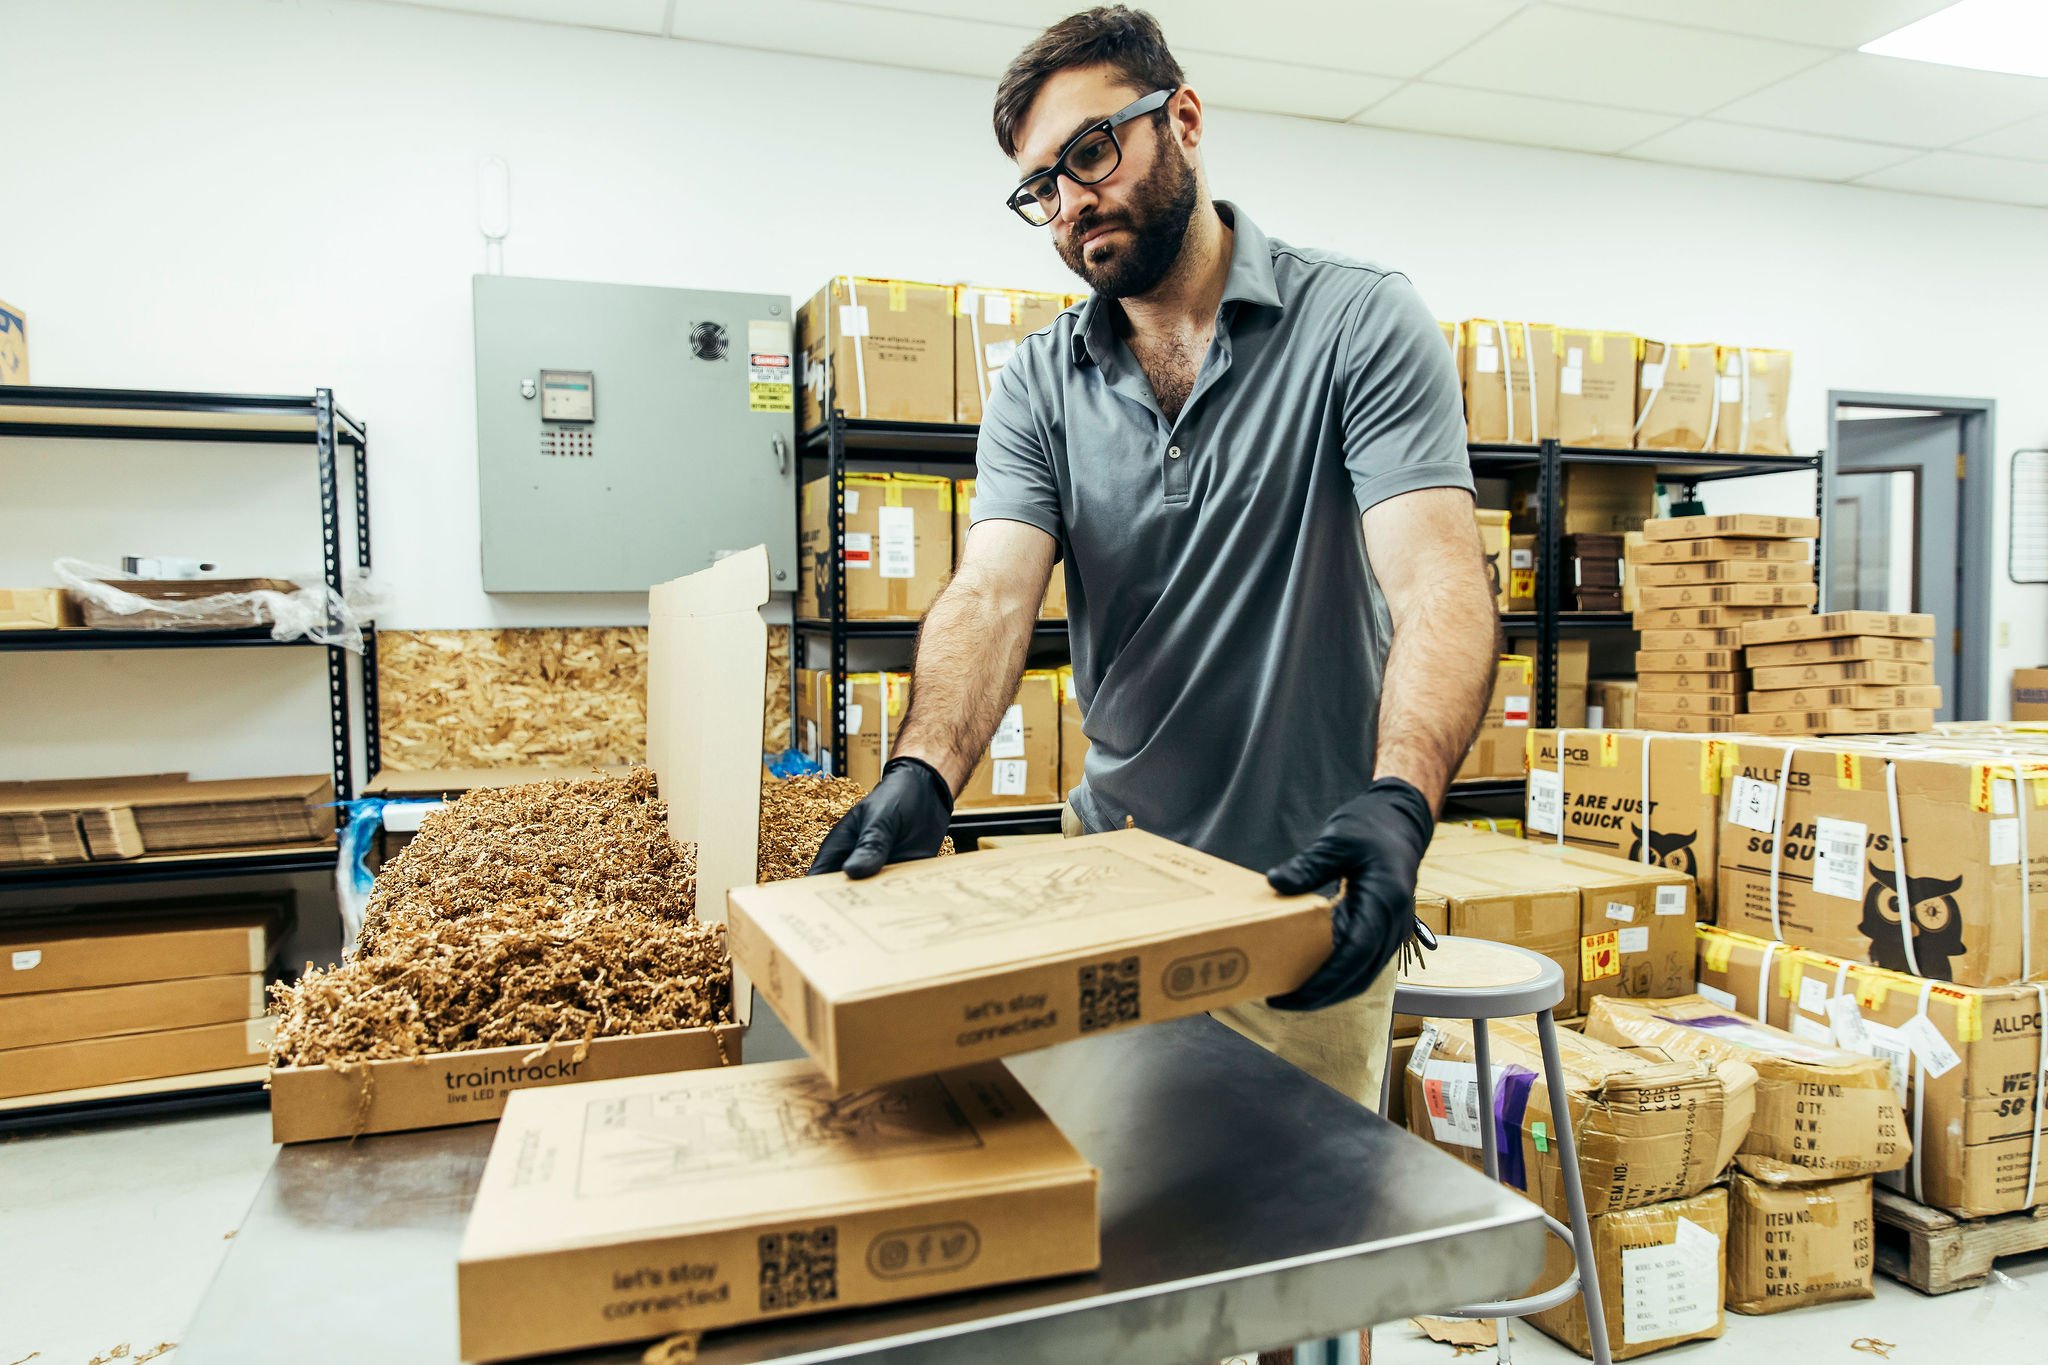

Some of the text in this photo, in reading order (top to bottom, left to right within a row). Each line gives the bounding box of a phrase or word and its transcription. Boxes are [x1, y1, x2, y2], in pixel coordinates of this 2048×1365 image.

[1574, 793, 1608, 809] ARE
[1571, 811, 1624, 829] QUICK
[1788, 822, 1816, 840] AR
[1992, 1013, 2042, 1034] ALLPC
[445, 1059, 583, 1090] traintrackr
[447, 1093, 468, 1104] live
[472, 1088, 494, 1101] LED
[1797, 1082, 1825, 1097] ITEM
[1639, 1087, 1652, 1112] PCS
[1998, 1098, 2026, 1117] SO
[1878, 1105, 1894, 1119] PCS
[1877, 1124, 1896, 1137] KGS
[1876, 1142, 1896, 1155] KGS
[1765, 1212, 1793, 1227] ITEM
[1853, 1218, 1868, 1234] PCS
[1853, 1236, 1869, 1252] KGS
[1854, 1254, 1869, 1269] KGS
